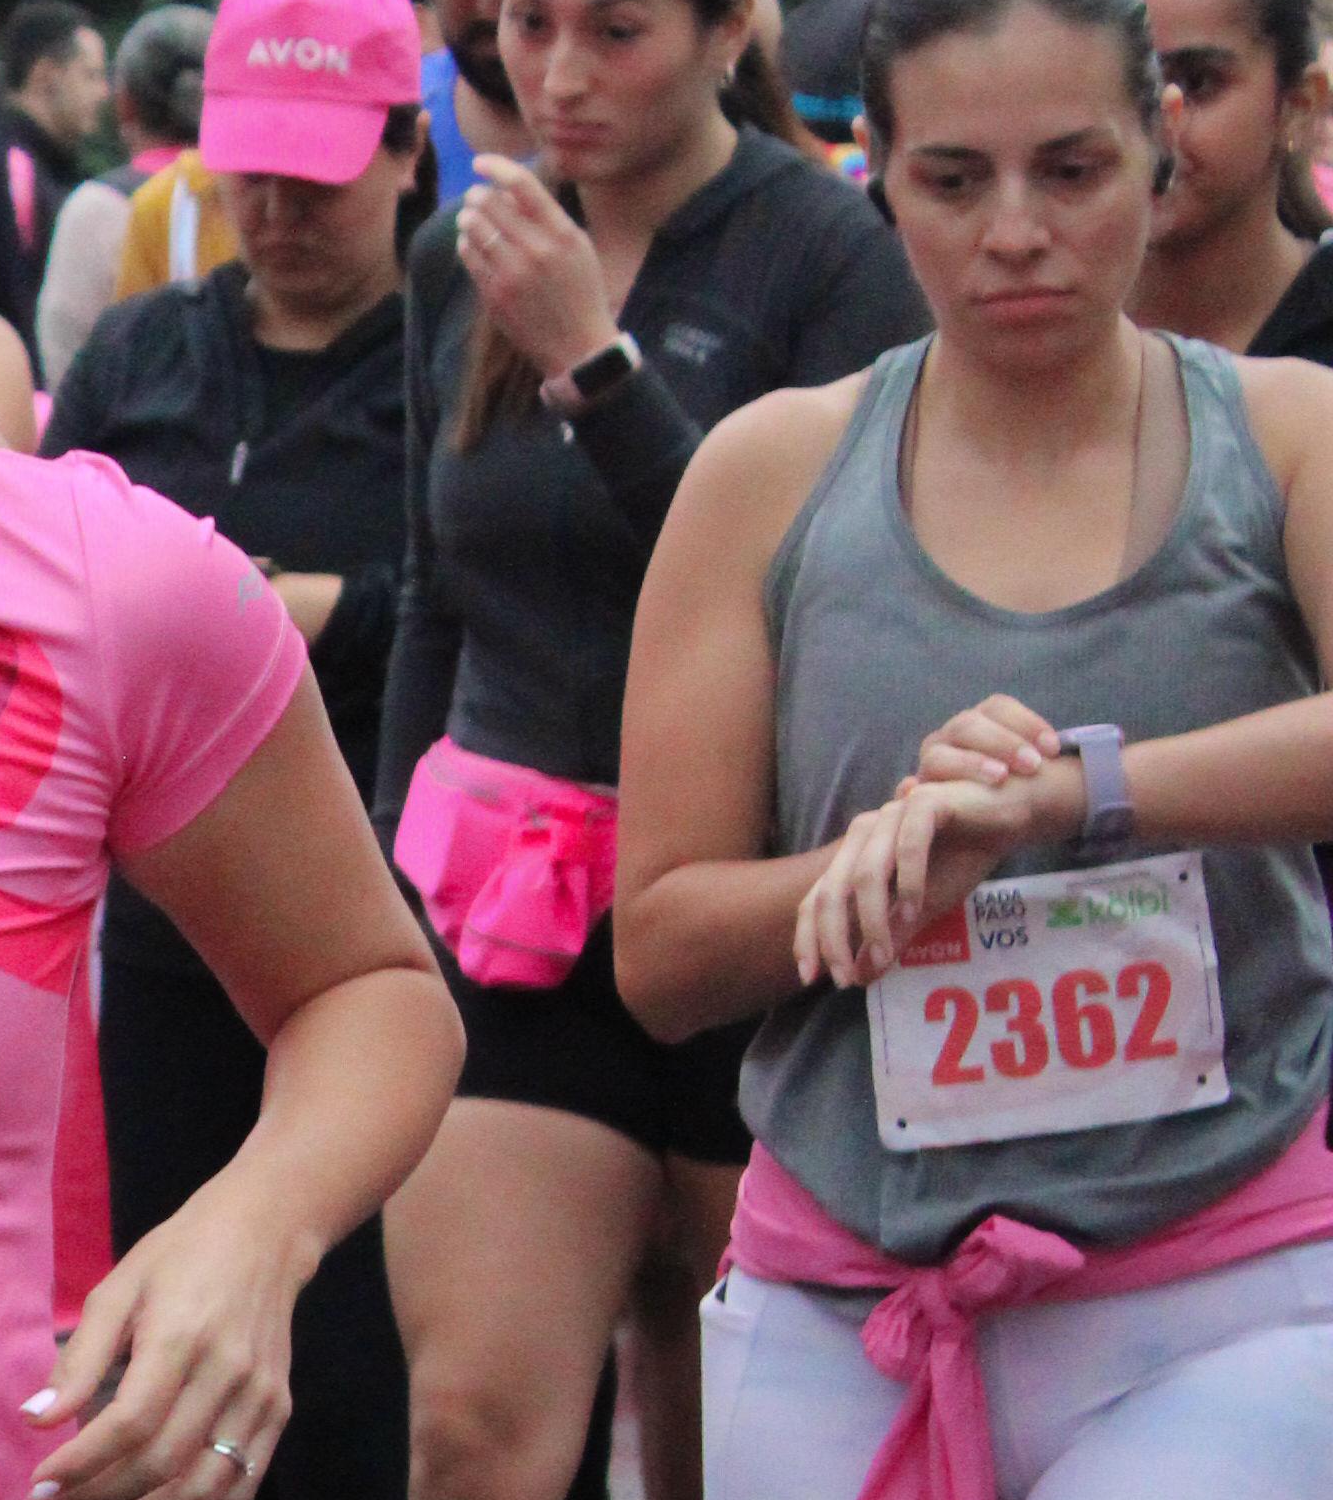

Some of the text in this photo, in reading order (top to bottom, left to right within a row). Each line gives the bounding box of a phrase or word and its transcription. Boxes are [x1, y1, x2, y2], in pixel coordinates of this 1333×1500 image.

[246, 36, 352, 76] AVON
[979, 926, 1030, 950] VOS
[923, 960, 1179, 1086] 2362
